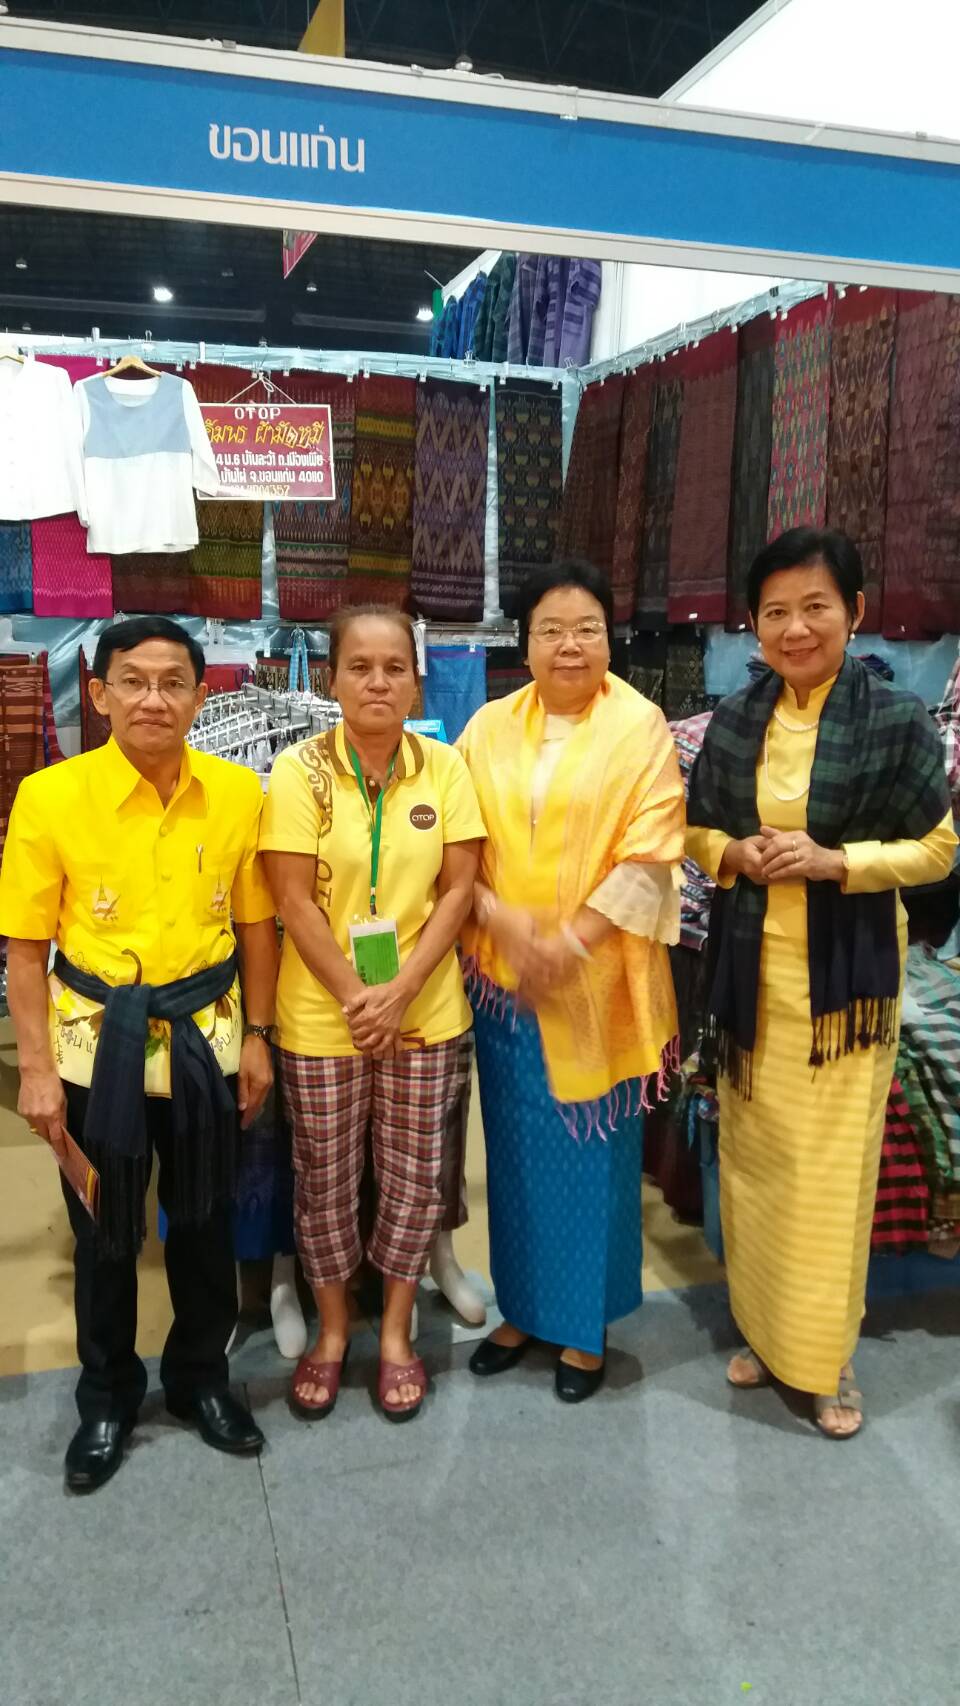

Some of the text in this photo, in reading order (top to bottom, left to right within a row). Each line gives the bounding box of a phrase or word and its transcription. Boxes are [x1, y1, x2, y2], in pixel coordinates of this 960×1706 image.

[209, 123, 365, 173] ขอนแก่น
[234, 407, 281, 420] OTOP
[249, 468, 296, 483] จ.ขอนแก่น
[298, 470, 324, 483] 40110
